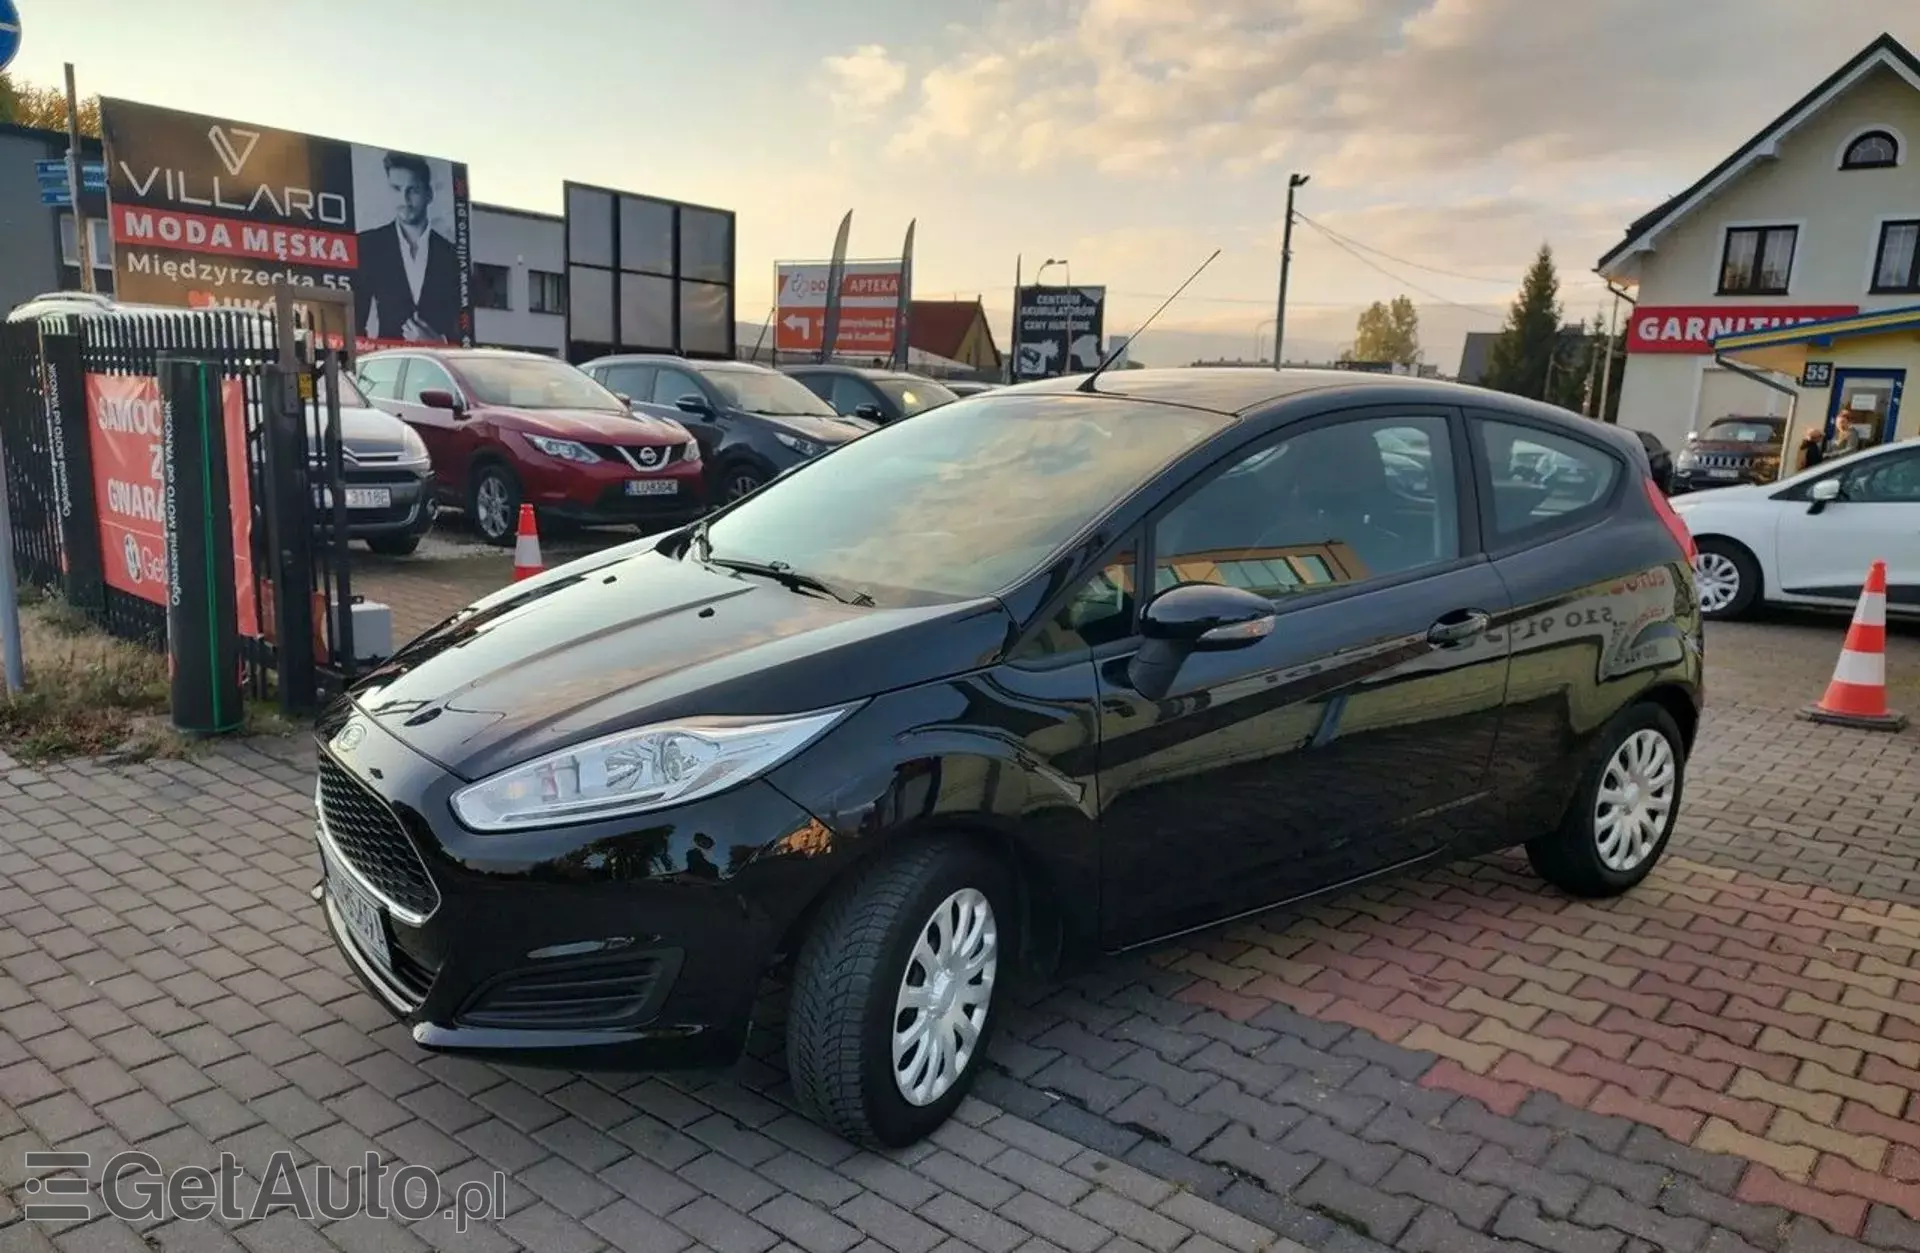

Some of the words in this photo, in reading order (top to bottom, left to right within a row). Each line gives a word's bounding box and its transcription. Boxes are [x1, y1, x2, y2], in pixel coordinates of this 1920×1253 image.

[119, 160, 347, 225] VILLARO
[125, 211, 232, 248] MODA
[242, 224, 350, 262] MĘSKA
[127, 252, 314, 287] Międzyrzecka
[322, 273, 350, 292] 55
[850, 279, 898, 292] APTEKA
[1806, 363, 1828, 381] 55
[166, 463, 175, 483] od
[166, 484, 177, 529] MOTO
